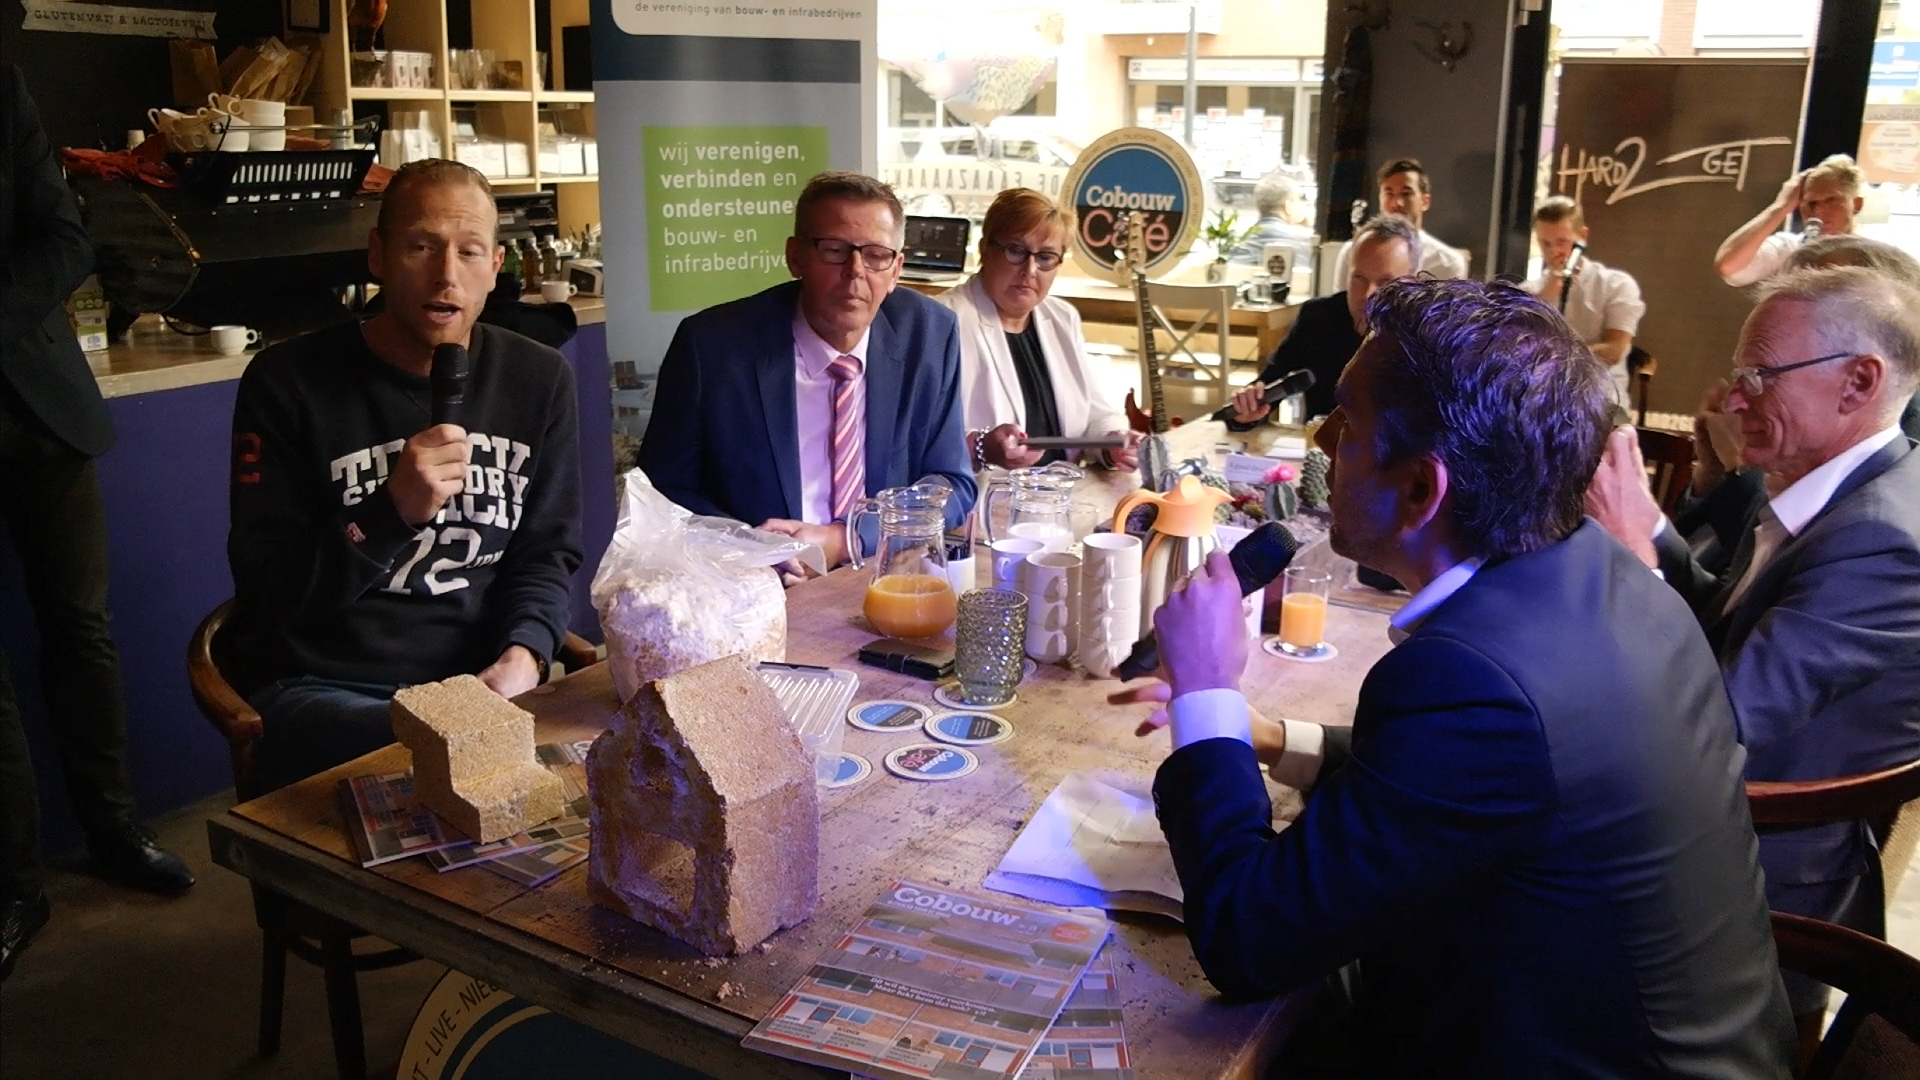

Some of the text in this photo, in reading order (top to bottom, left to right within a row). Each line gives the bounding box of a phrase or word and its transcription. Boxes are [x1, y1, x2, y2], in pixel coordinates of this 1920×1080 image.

[34, 10, 114, 25] GLUTENVRIJ
[635, 2, 862, 20] de vereniging van bouw- en infrabedrijven
[659, 141, 806, 166] wij verenigen,
[660, 169, 797, 189] verbinden en
[1085, 185, 1176, 211] Cobouw
[664, 227, 757, 246] bouw- en
[1082, 209, 1171, 253] Caé
[893, 886, 1020, 926] Cobouw
[424, 1009, 457, 1056] LIVE
